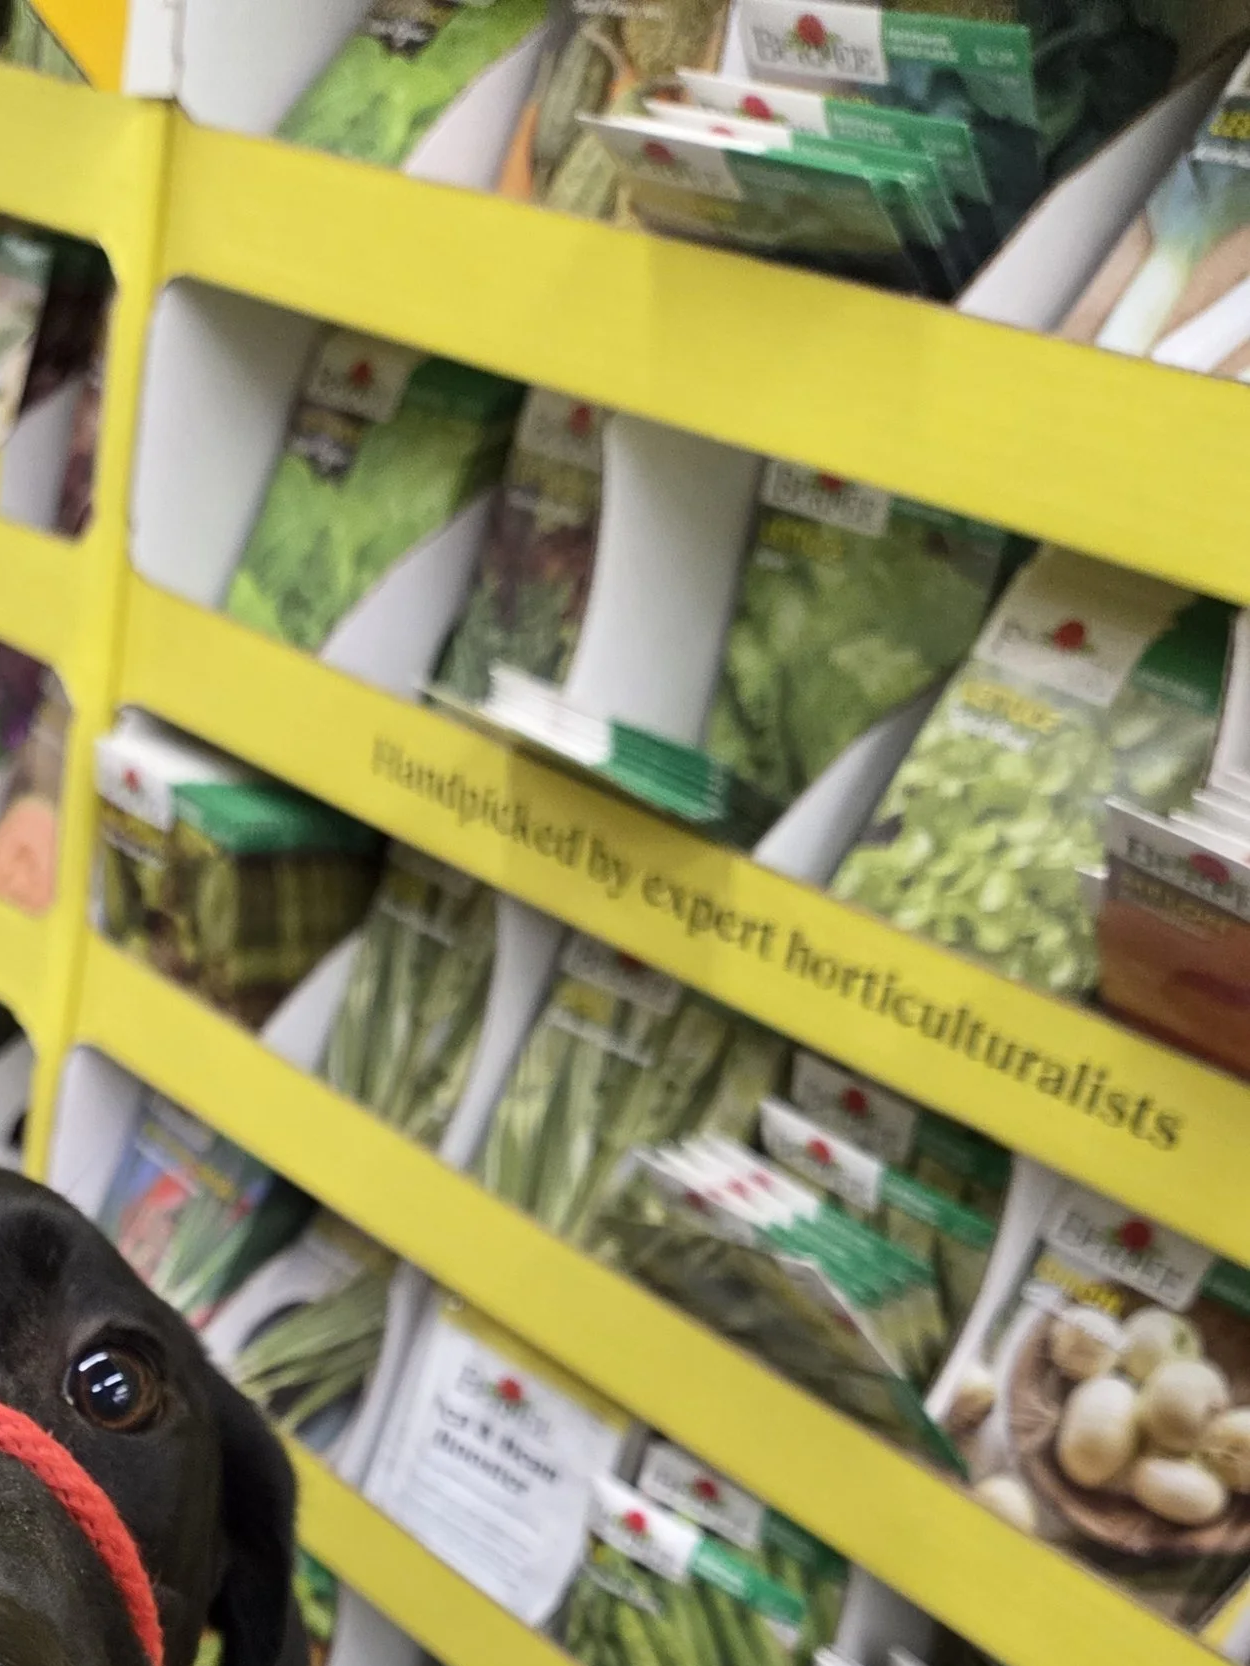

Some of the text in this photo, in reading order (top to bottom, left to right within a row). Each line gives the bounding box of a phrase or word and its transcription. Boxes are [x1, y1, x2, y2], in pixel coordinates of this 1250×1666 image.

[371, 733, 585, 869] Handpicked
[588, 835, 633, 899] by
[640, 873, 780, 960] expert
[783, 929, 1184, 1151] horticulturalists
